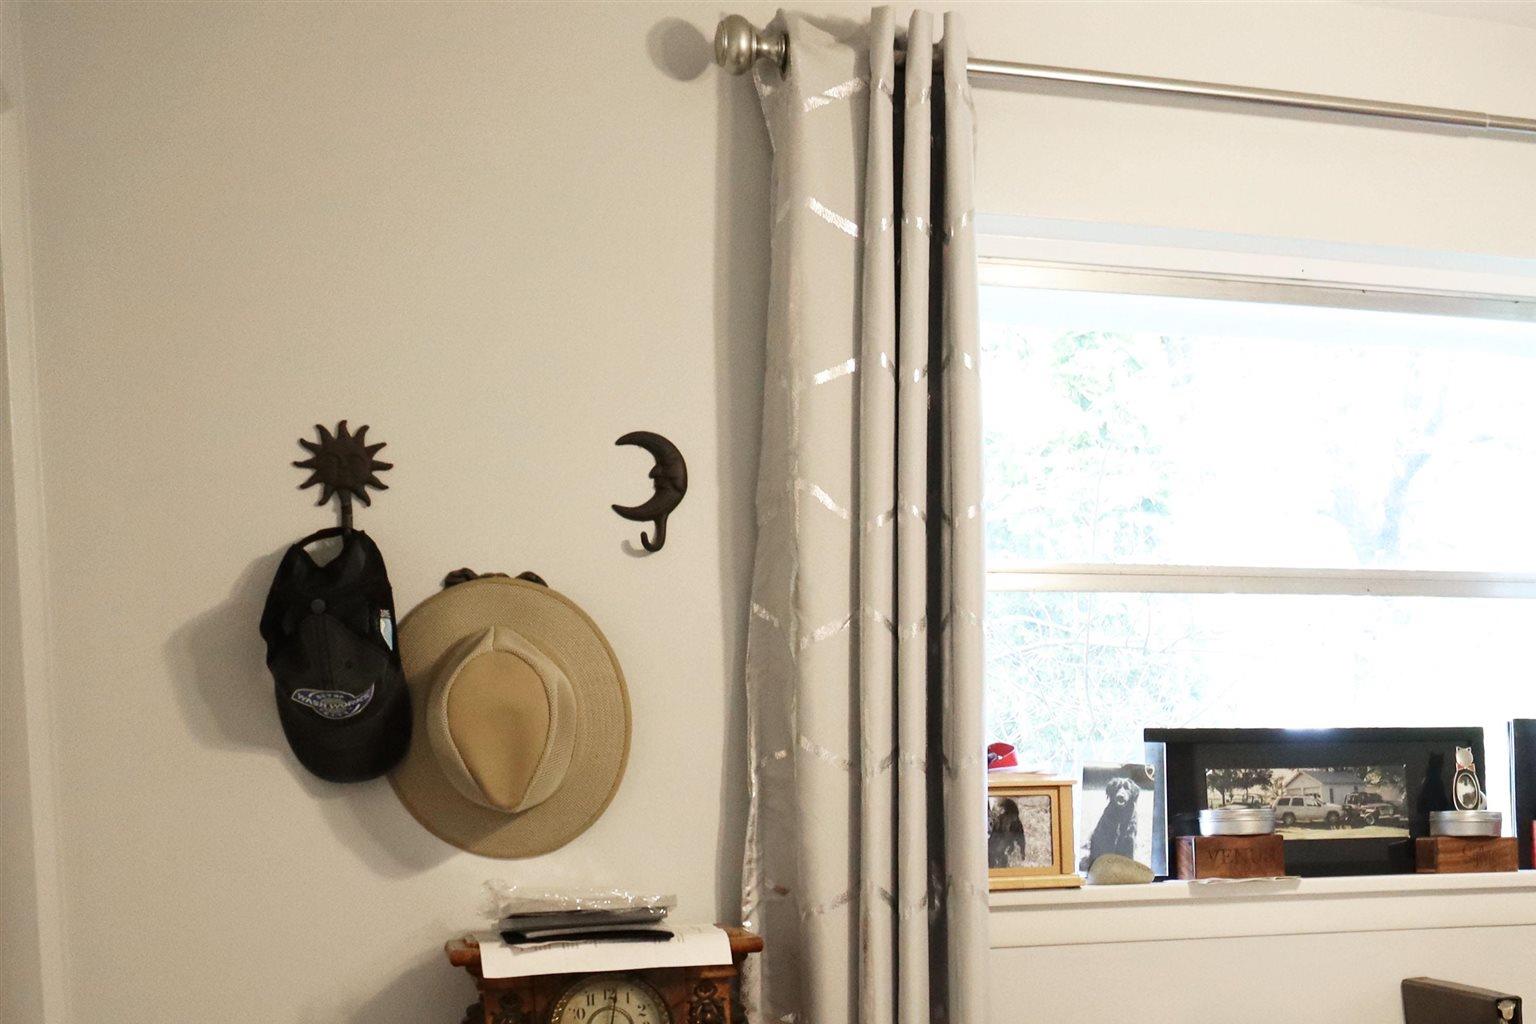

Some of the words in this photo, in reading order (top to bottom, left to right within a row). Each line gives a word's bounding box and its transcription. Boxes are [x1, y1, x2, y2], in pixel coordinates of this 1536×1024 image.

[586, 993, 595, 1006] 11
[626, 992, 630, 1004] 1
[637, 1004, 647, 1017] 2
